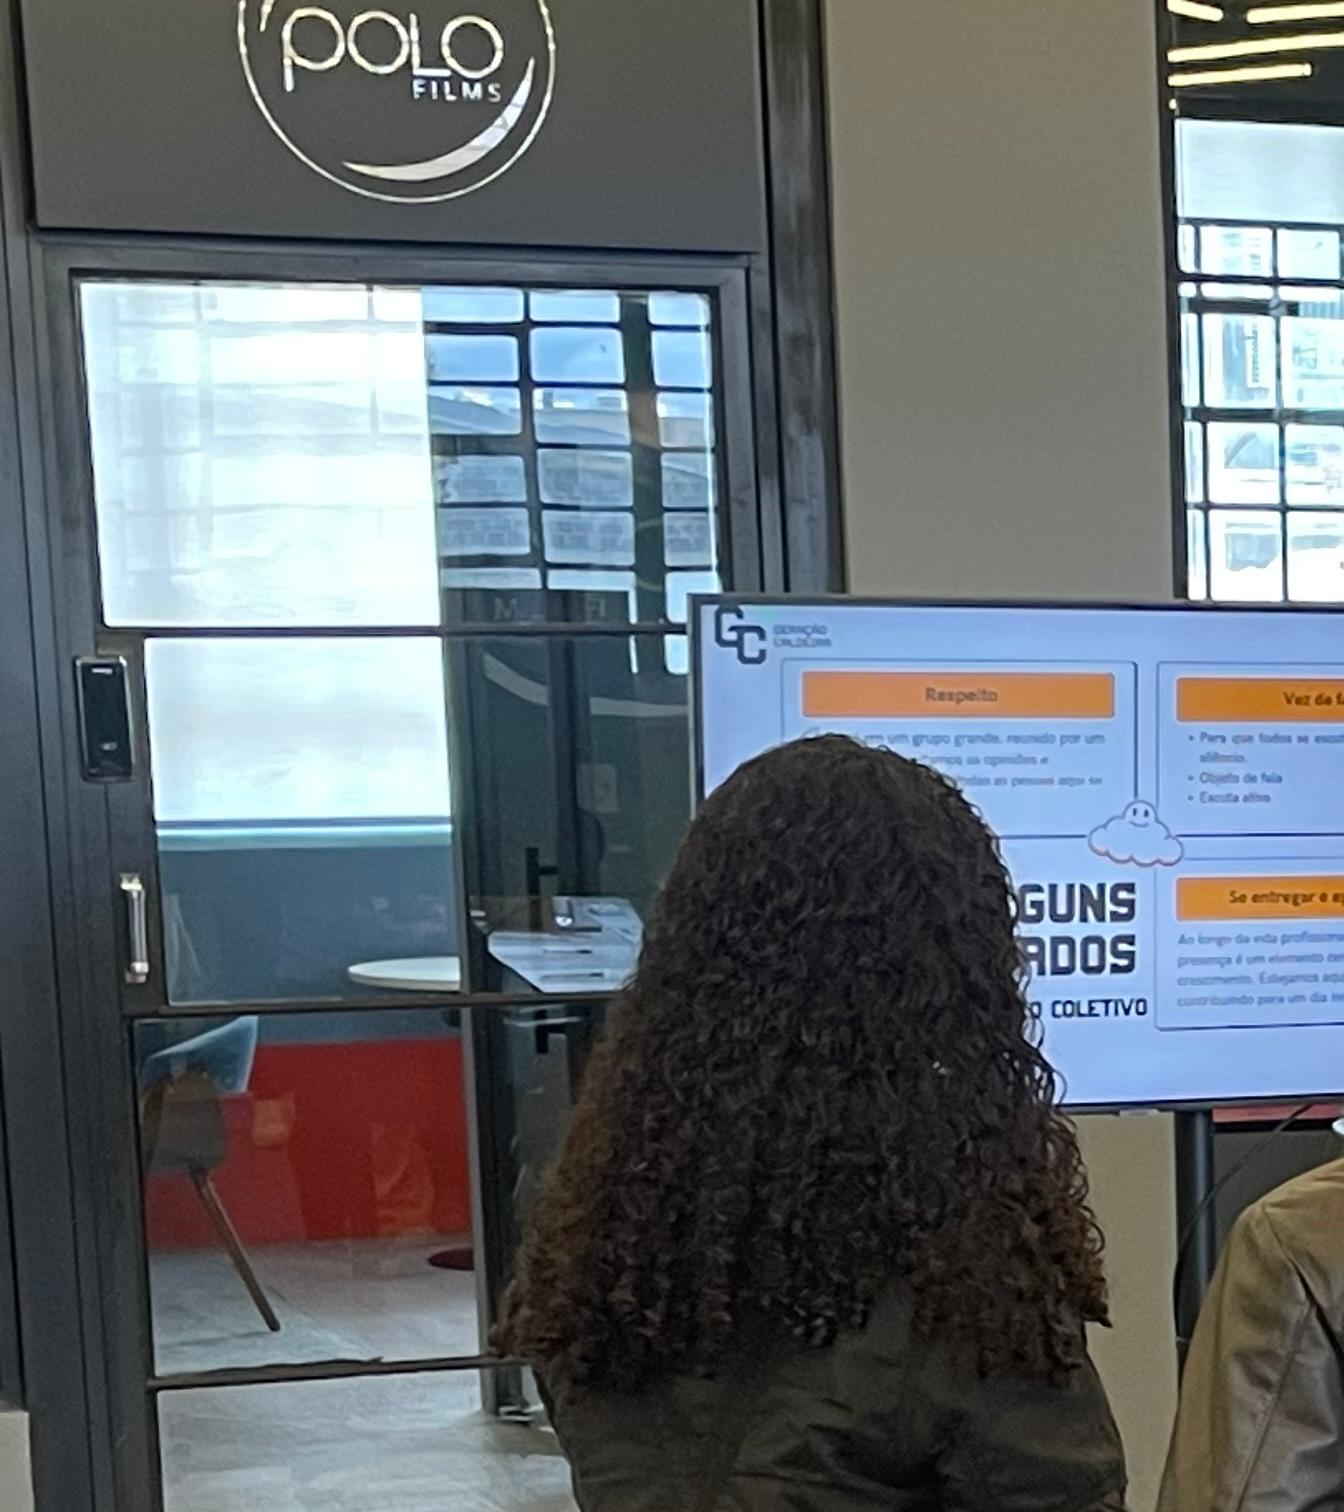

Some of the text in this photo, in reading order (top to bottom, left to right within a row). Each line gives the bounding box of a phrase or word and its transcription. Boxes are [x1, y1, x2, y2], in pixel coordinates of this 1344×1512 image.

[411, 78, 502, 103] FILMS
[925, 687, 999, 704] Respeito
[1283, 692, 1311, 706] Vez
[1314, 692, 1333, 706] de
[912, 733, 951, 748] grupo
[1018, 882, 1136, 924] GUNS
[1018, 934, 1136, 977] ADOS
[1051, 998, 1148, 1018] COLETIVO
